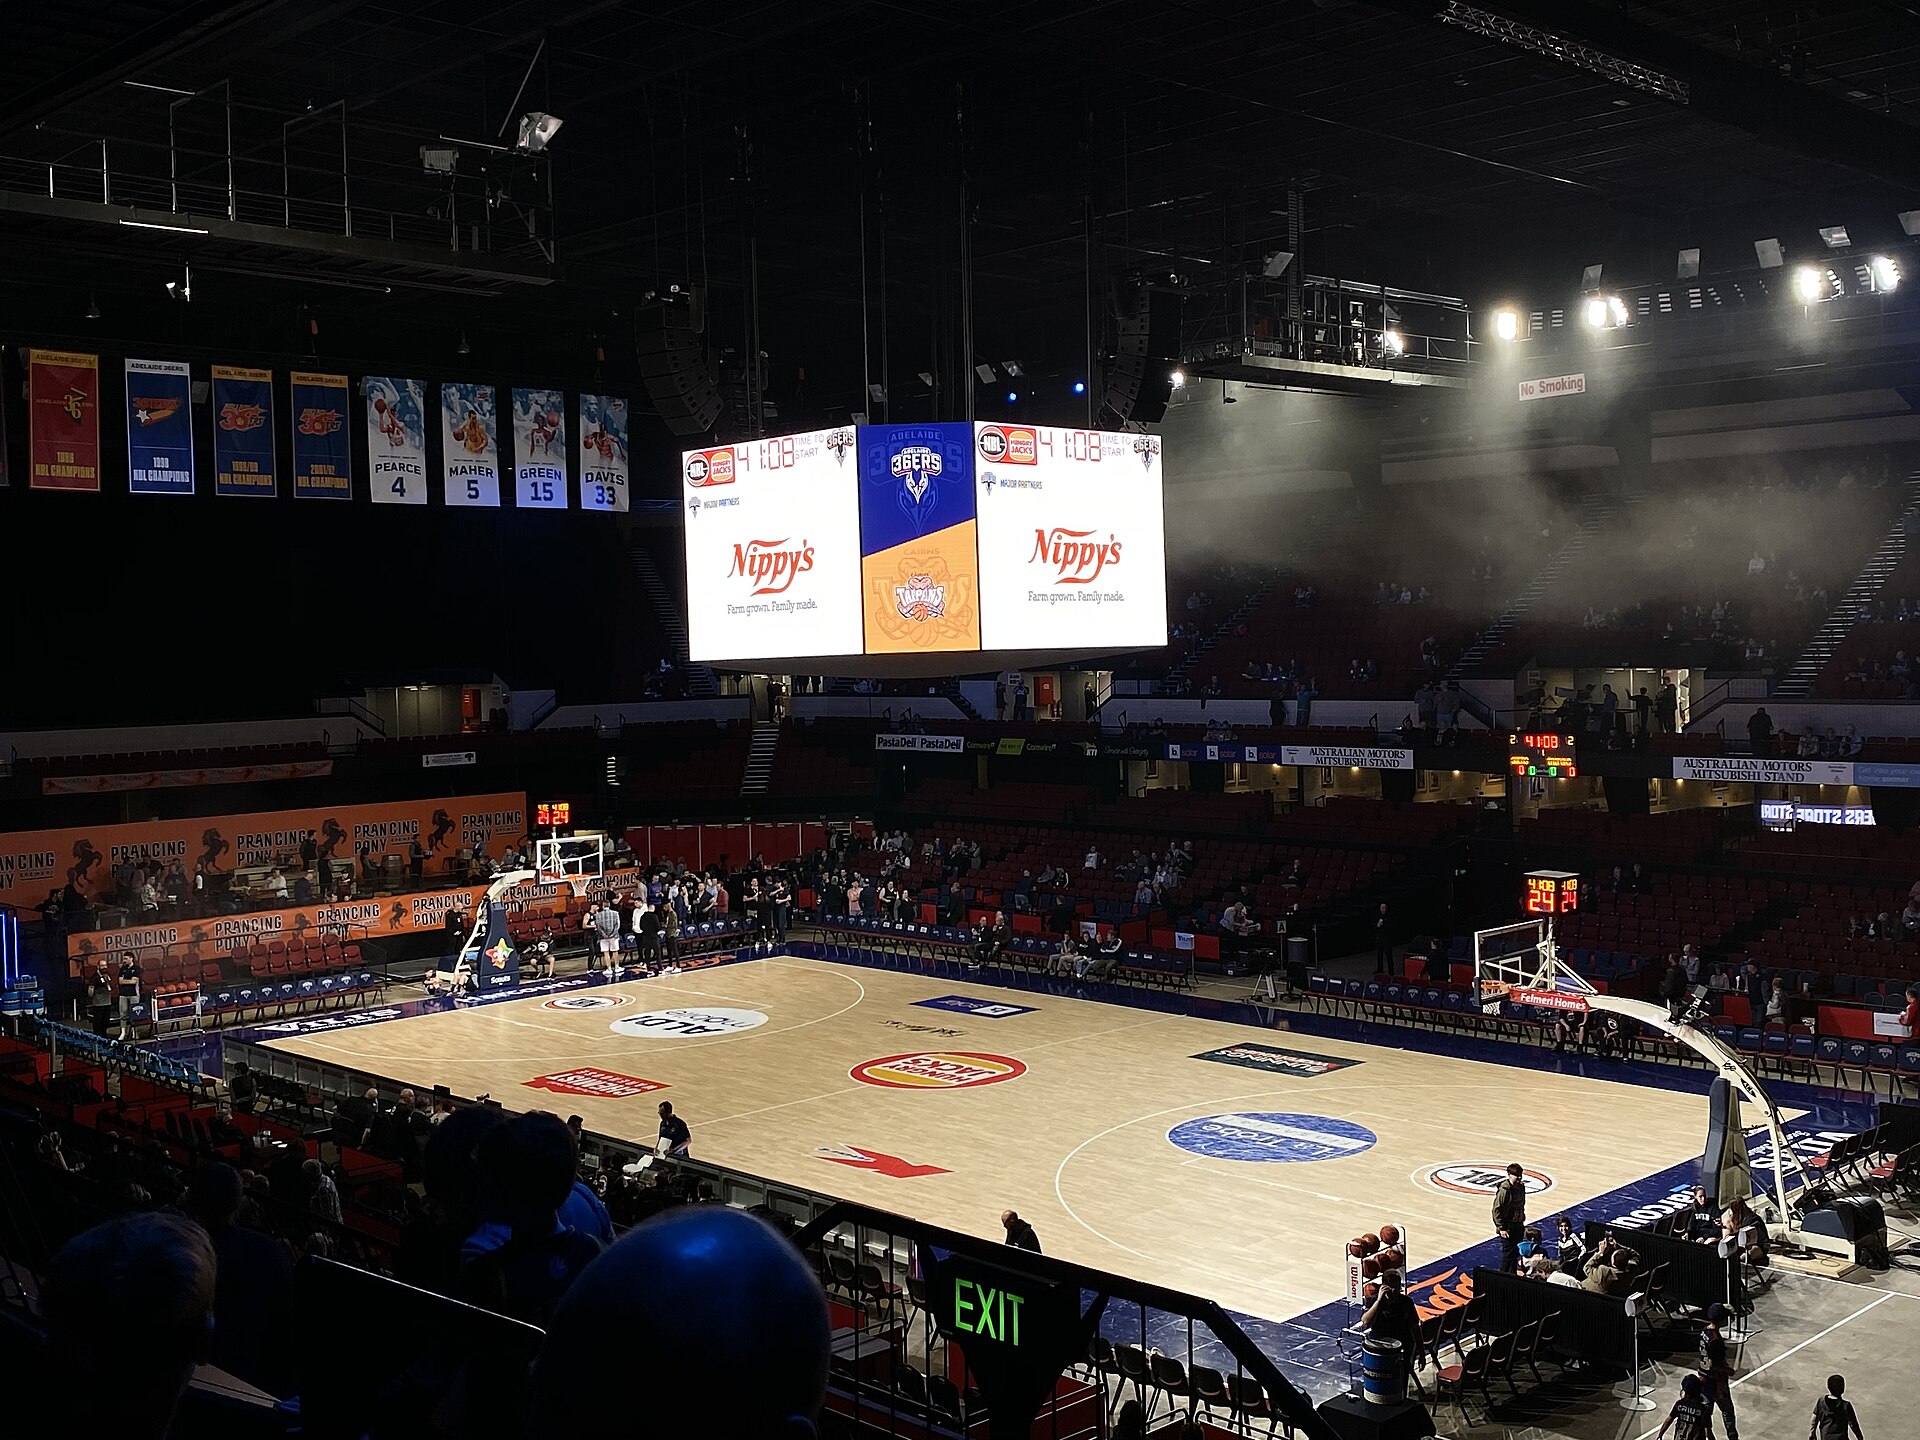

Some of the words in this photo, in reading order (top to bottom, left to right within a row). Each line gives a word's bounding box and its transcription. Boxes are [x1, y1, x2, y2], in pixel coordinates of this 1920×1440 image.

[35, 354, 69, 363] ADELAIDE
[131, 362, 163, 371] ADELAIDE
[1521, 383, 1535, 396] No
[1539, 377, 1584, 393] Smoking
[795, 434, 813, 446] TIME
[814, 433, 825, 444] TO
[826, 431, 855, 451] 36ERS
[890, 431, 941, 442] ADELAIDE
[983, 435, 1002, 451] NBL
[1010, 439, 1033, 447] HUNGRY
[1101, 435, 1119, 445] TIME
[1121, 436, 1132, 446] TO
[795, 447, 819, 460] START
[1010, 446, 1033, 455] JACK'S
[1101, 446, 1125, 456] START
[1133, 439, 1160, 455] 36ERS
[375, 462, 422, 475] PEARCE
[689, 462, 705, 478] NBL
[712, 459, 731, 467] HUNGRY
[892, 453, 941, 473] 36ERS
[35, 463, 49, 477] NBL
[50, 465, 96, 479] CHAMPIONS
[133, 469, 148, 482] NBL
[148, 470, 190, 483] CHAMPIONS
[449, 465, 494, 479] MAHER
[520, 467, 562, 481] GREEN
[585, 471, 625, 486] DAVIS
[233, 474, 273, 486] CHAMPIONS
[311, 476, 349, 489] CHAMPIONS
[391, 477, 406, 498] 4
[1000, 478, 1017, 488] MAJOR
[1017, 479, 1042, 490] PARTNERS
[466, 479, 480, 500] 5
[530, 481, 554, 502] 15
[595, 485, 616, 505] 33
[718, 497, 740, 507] PARTNERS
[903, 547, 941, 556] CAIRNS
[1028, 527, 1122, 585] Nippy's
[727, 537, 815, 597] Nippy's
[896, 585, 944, 608] TAIPANS
[1028, 590, 1048, 602] Farm
[1050, 593, 1076, 605] grown.
[1077, 590, 1102, 605] Family
[1103, 590, 1125, 602] made.
[727, 604, 745, 614] Farm
[746, 604, 770, 617] grown.
[771, 600, 795, 614] Family
[796, 598, 818, 610] made.
[1510, 734, 1516, 745] 2
[1525, 735, 1559, 749] 41:08
[1567, 735, 1574, 746] 2
[1181, 748, 1199, 757] solar
[1309, 747, 1365, 758] AUSTRALIAN
[1368, 749, 1406, 759] MOTORS
[1315, 756, 1367, 767] MITSUBISHI
[1370, 758, 1400, 768] STAND
[1683, 758, 1758, 770] AUSTRALIAN
[1762, 760, 1812, 773] MOTORS
[1519, 765, 1526, 776] 0
[1529, 766, 1536, 776] 0
[1549, 766, 1557, 777] 0
[1569, 766, 1576, 777] 0
[1691, 769, 1761, 781] MITSUBISHI
[1764, 771, 1805, 782] STAND
[462, 810, 522, 829] PRANCING
[553, 810, 569, 825] 24
[354, 820, 419, 838] PRANCING
[462, 829, 493, 844] PONY
[237, 830, 307, 850] PRANCING
[354, 839, 387, 854] PONY
[111, 840, 186, 862] PRANCING
[1529, 889, 1554, 912] 24
[1561, 890, 1577, 913] 24
[318, 904, 381, 924] PRANCING
[414, 911, 445, 927] PONY
[215, 915, 282, 937] PRANCING
[1278, 922, 1286, 932] A
[105, 927, 178, 949] PRANCING
[490, 974, 512, 985] Scouts
[1520, 992, 1553, 1006] Felmeri
[1554, 997, 1586, 1010] Homes
[620, 1015, 725, 1035] ALDI
[664, 1009, 755, 1029] mobile
[1214, 1049, 1328, 1073] BUNNINGS
[881, 1063, 973, 1083] HUNGRY
[546, 1073, 643, 1096] CHEMIST
[1202, 1123, 1280, 1148] Trobe
[1350, 1265, 1359, 1299] Wilson
[955, 1277, 1025, 1346] EXIT
